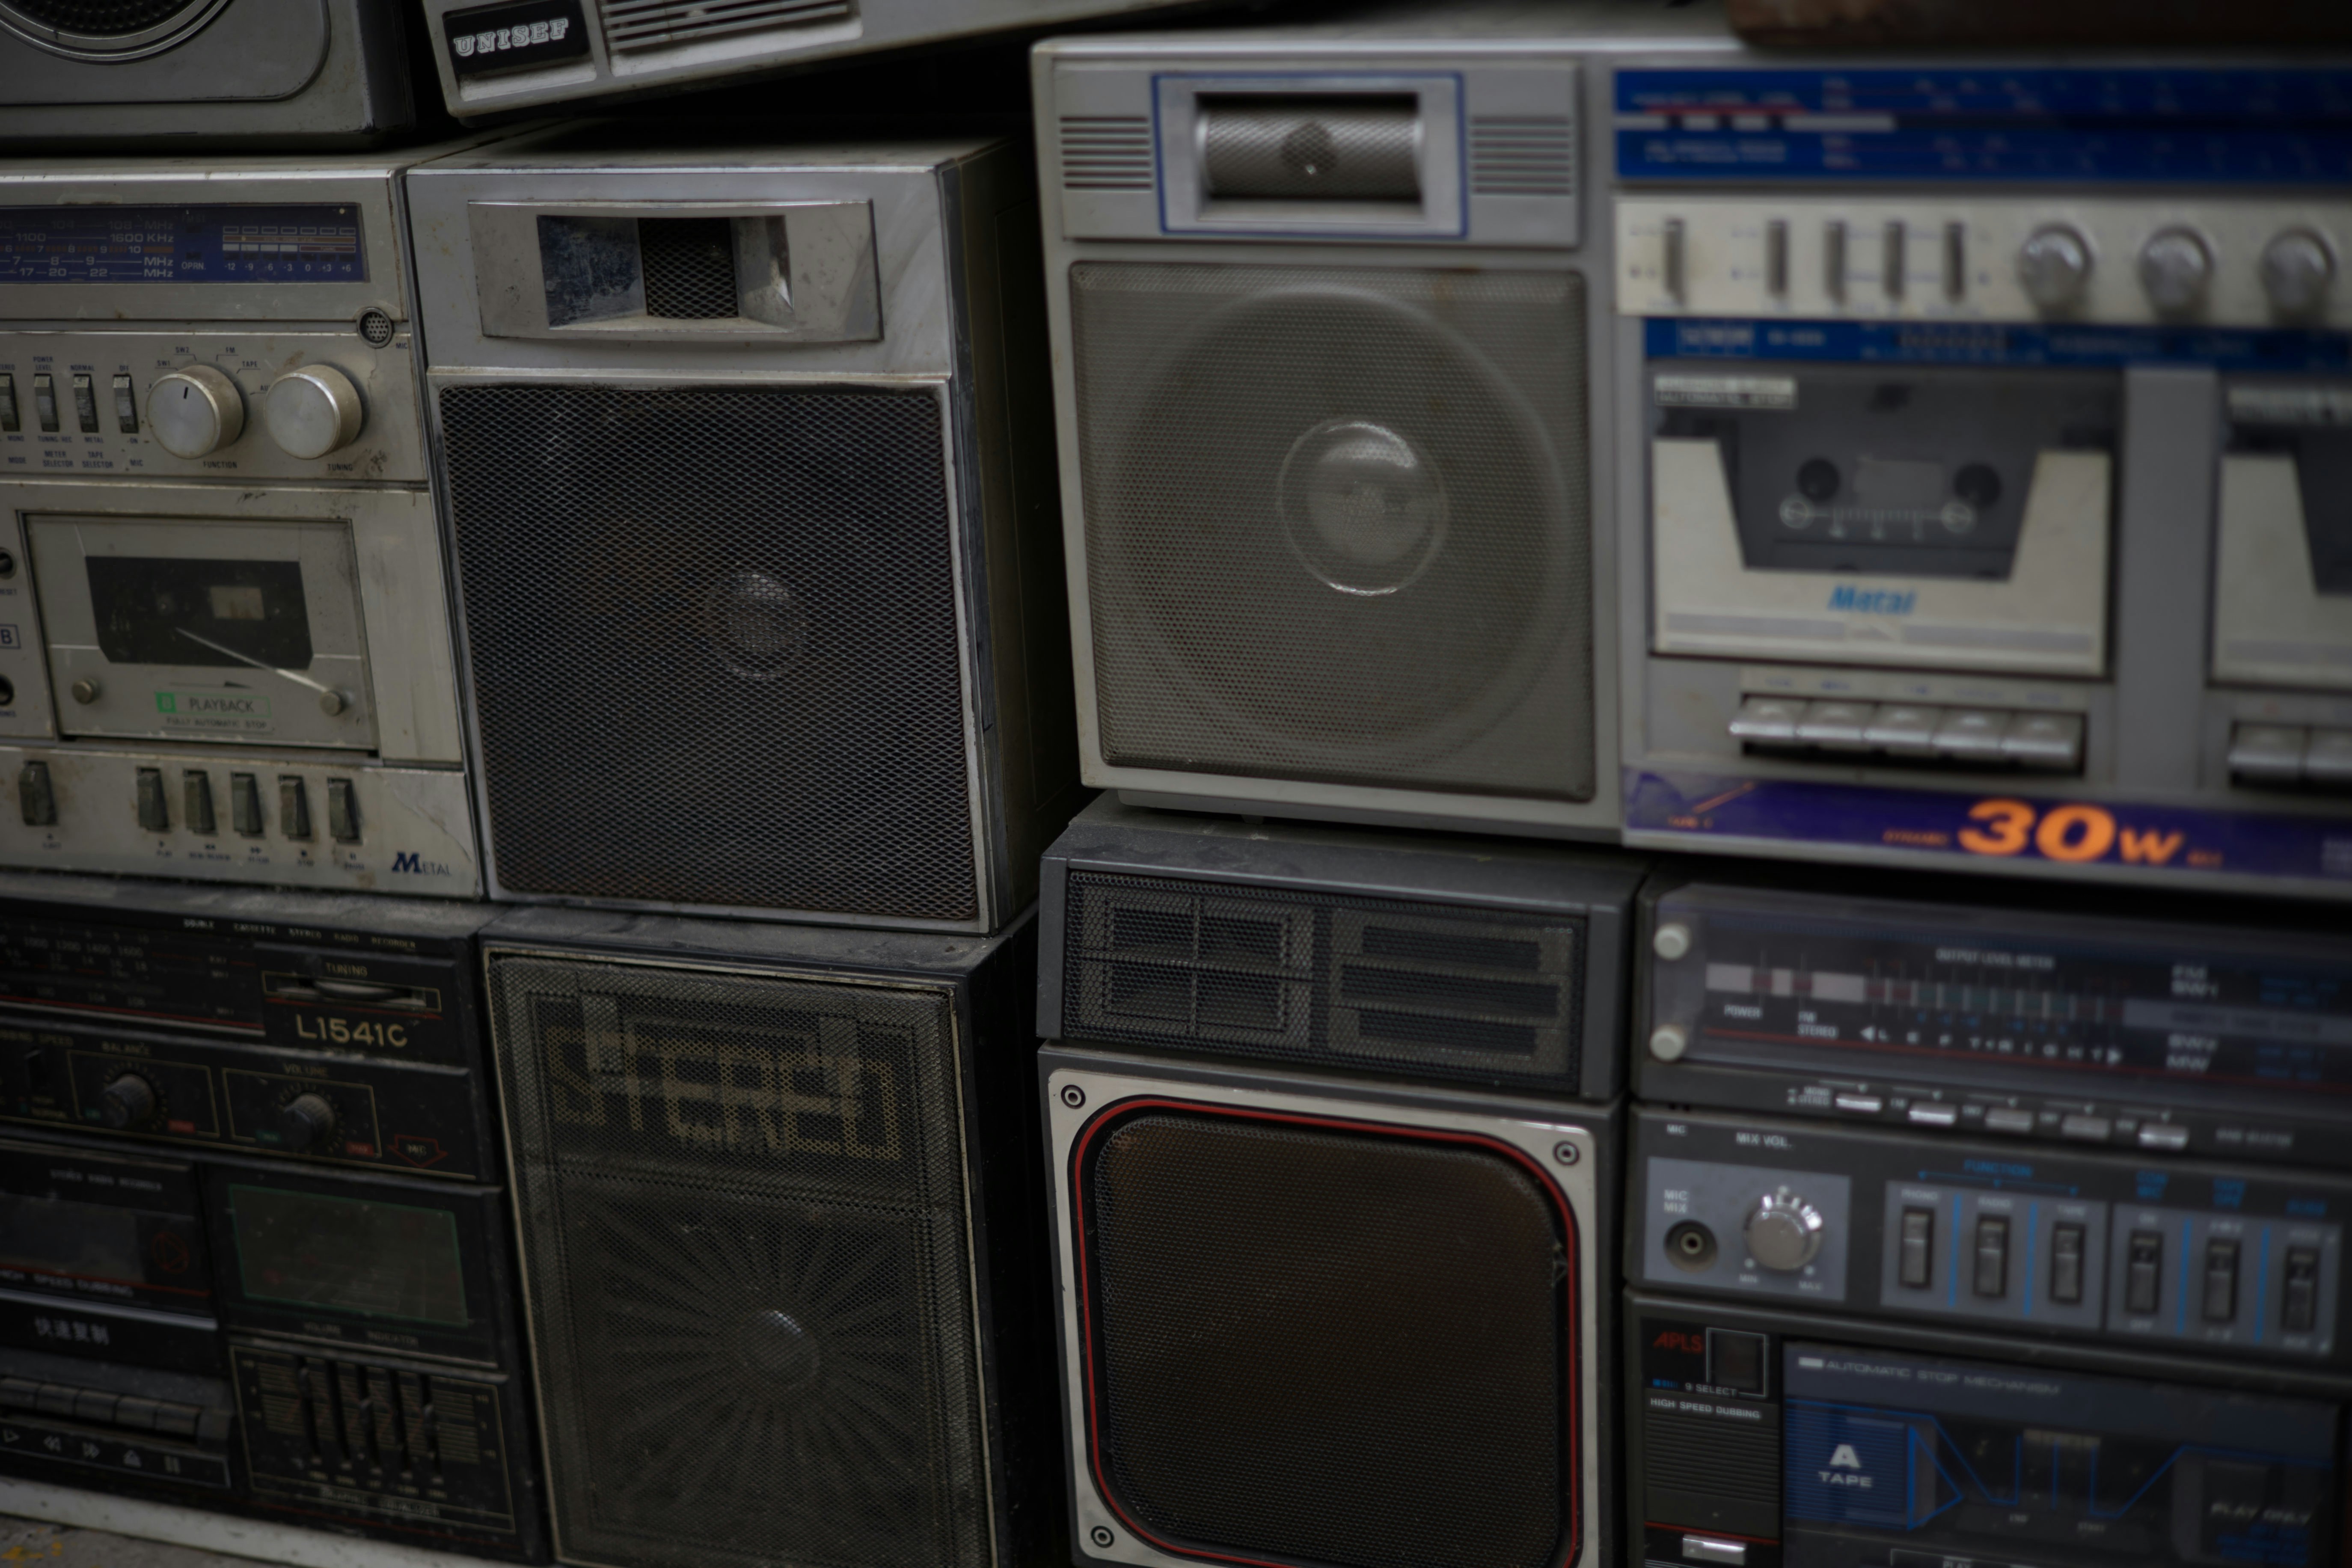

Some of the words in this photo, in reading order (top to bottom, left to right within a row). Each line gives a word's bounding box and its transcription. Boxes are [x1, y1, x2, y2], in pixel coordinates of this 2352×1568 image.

[454, 17, 569, 57] UNISEF
[51, 220, 75, 229] 104
[108, 220, 132, 230] 108
[144, 220, 174, 230] MHz
[16, 233, 46, 242] 1100
[110, 234, 143, 243] 1600
[147, 234, 175, 243] KHz
[13, 256, 21, 266] 7
[50, 256, 59, 266] 8
[86, 256, 95, 266] 9
[144, 257, 174, 267] MHz
[181, 262, 206, 270] OPRN.
[224, 263, 236, 271] -12
[284, 264, 293, 272] -3
[342, 264, 351, 272] +6
[20, 268, 34, 276] 17
[48, 268, 67, 276] 20
[89, 268, 108, 277] 22
[144, 268, 174, 278] MHz
[328, 463, 353, 472] TUNING
[1827, 585, 1917, 613] Metal
[190, 698, 254, 713] PLAYBACK
[195, 719, 240, 728] AUTOMATIC
[183, 918, 215, 929] DOUBLE
[233, 923, 276, 935] CASSETTE
[288, 928, 322, 939] STEREO
[333, 932, 359, 943] RADIO
[371, 936, 416, 949] RECORDER
[1935, 947, 1977, 963] OUTPUT
[1981, 952, 2013, 967] LEVEL
[2016, 955, 2055, 971] METER
[325, 961, 368, 977] TUNING
[2172, 964, 2208, 980] FM
[1724, 1004, 1762, 1019] POWER
[1798, 1010, 1817, 1023] FM
[296, 1013, 408, 1048] L1541C
[1797, 1024, 1839, 1039] STEREO
[101, 1041, 151, 1057] BALANCE
[2166, 1053, 2211, 1072] MW
[282, 1063, 329, 1078] VOLUME
[1804, 1086, 1832, 1096] MONO
[1797, 1095, 1830, 1106] STEREO
[1666, 1124, 1687, 1136] MIC
[1736, 1132, 1760, 1146] MIX
[1763, 1134, 1794, 1149] VOL.
[406, 1143, 426, 1156] MIC
[1964, 1159, 2033, 1178] FUNCTION
[1664, 1189, 1688, 1201] MIC
[1901, 1188, 1939, 1201] PHONO
[1663, 1201, 1688, 1213] MIX
[1977, 1196, 2013, 1209] RADIO
[2055, 1203, 2086, 1216] TAPE
[33, 1272, 74, 1289] SPEED
[76, 1279, 135, 1298] DUBBING
[1739, 1273, 1758, 1284] MIN
[1798, 1280, 1822, 1291] MAX
[33, 1315, 110, 1346] 快速复制
[304, 1322, 342, 1335] VOLUME
[366, 1330, 419, 1347] INDICATOR
[1653, 1331, 1704, 1355] APLS
[1826, 1361, 1910, 1378] AUTOMATIC
[1917, 1370, 1957, 1383] STOP
[1964, 1375, 2060, 1394] MECHANISM
[1696, 1384, 1737, 1397] SELECT
[1650, 1397, 1675, 1408] HIGH
[1679, 1401, 1712, 1412] SPEED
[1716, 1405, 1761, 1420] DUBBING
[1829, 1443, 1861, 1468] A
[1818, 1471, 1873, 1488] TAPE
[378, 1496, 440, 1518] EQUALIZER
[2210, 1502, 2260, 1519] PLAY
[2262, 1509, 2313, 1526] ONLY
[2009, 1513, 2028, 1523] END
